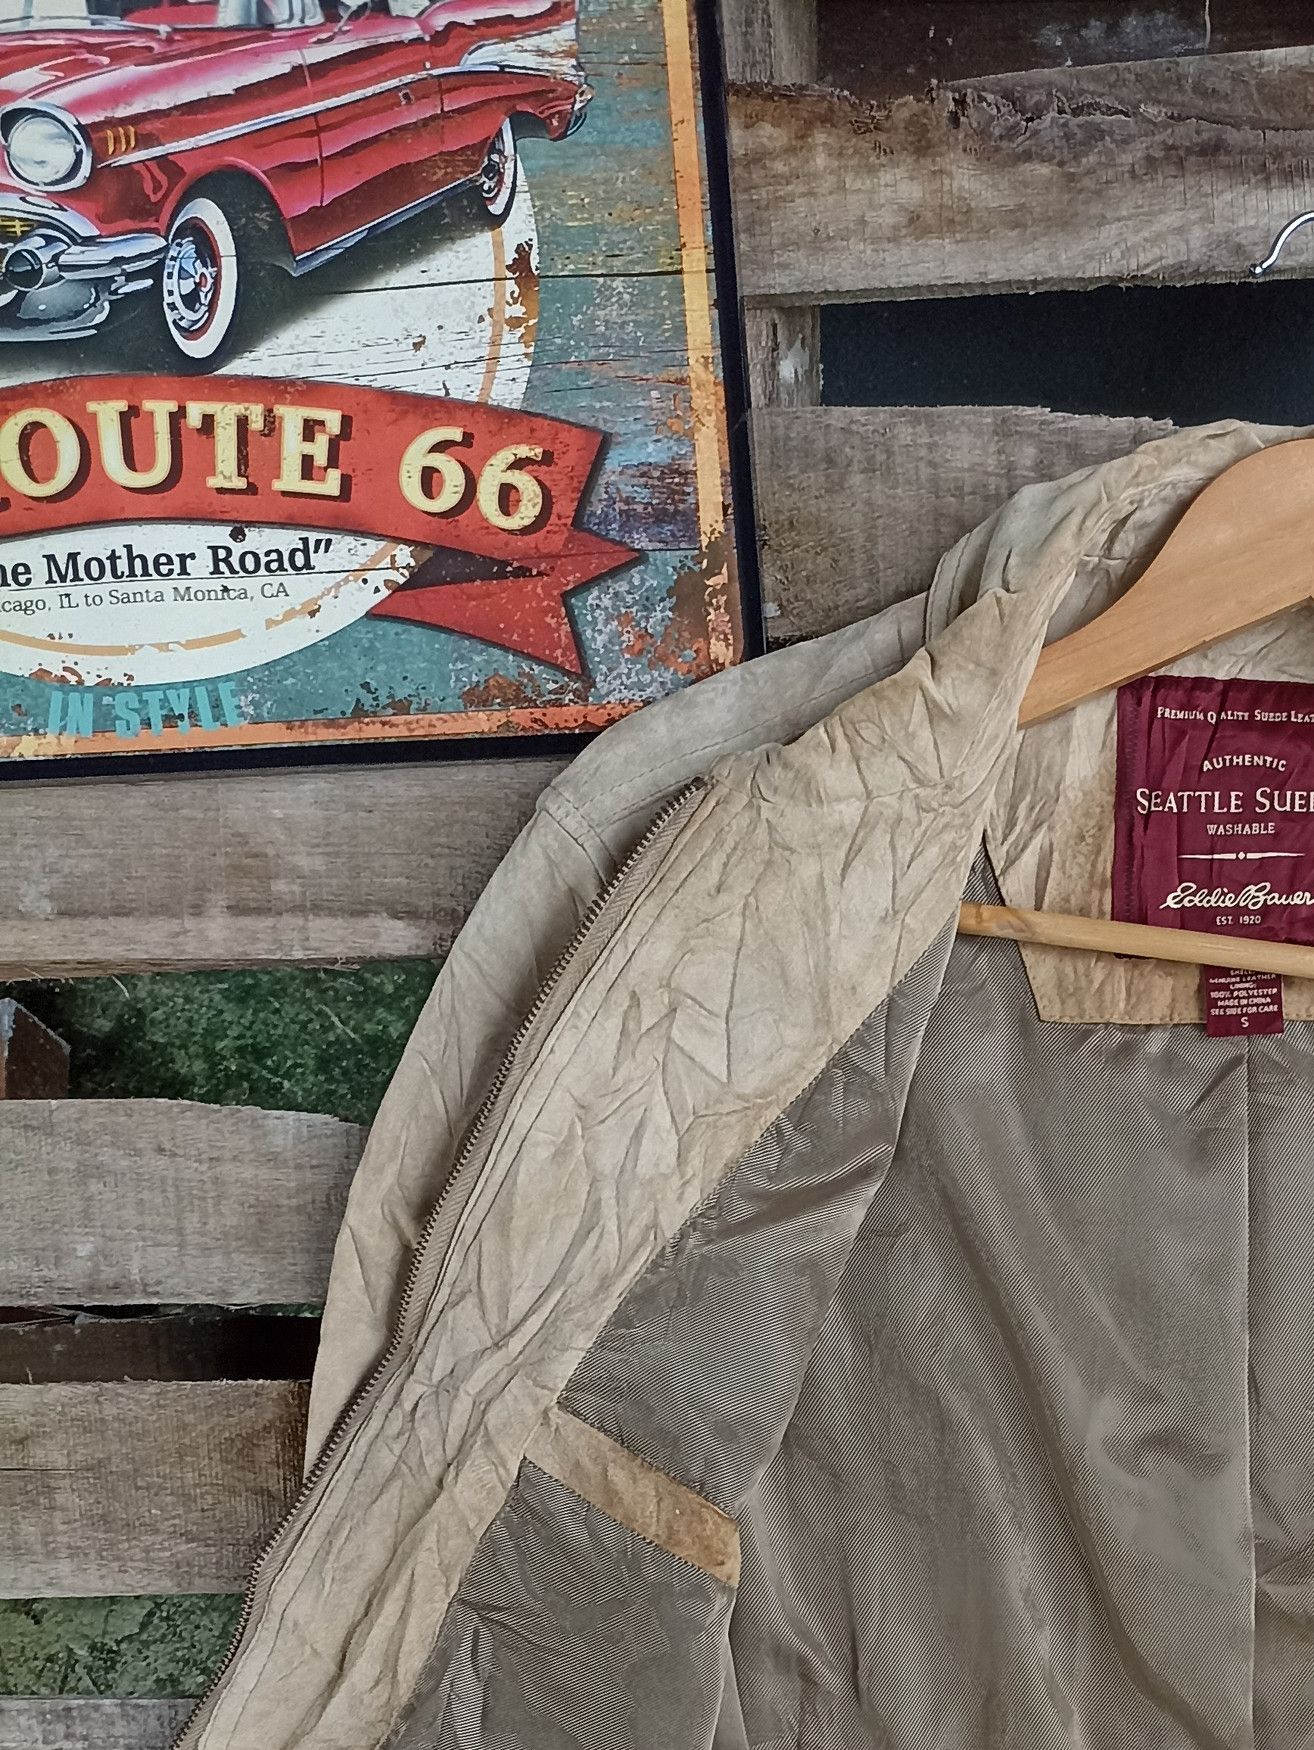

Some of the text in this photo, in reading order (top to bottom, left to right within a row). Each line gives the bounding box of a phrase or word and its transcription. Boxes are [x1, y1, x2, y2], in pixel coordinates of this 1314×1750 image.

[0, 400, 545, 532] OUTE 66
[42, 544, 196, 585] Mother
[207, 537, 333, 576] Road"
[0, 598, 52, 616] cago,
[84, 593, 104, 607] to
[108, 588, 165, 606] Santa
[173, 583, 254, 603] Monica,
[260, 581, 289, 599] CA
[48, 681, 245, 740] IN STYLE
[1157, 706, 1204, 721] PREMIUM
[1207, 711, 1250, 725] QALITY
[1254, 709, 1288, 722] SUEDE
[1202, 754, 1287, 772] AUTHENTIC
[1136, 788, 1243, 814] SEATTLE
[1206, 822, 1276, 836] WASHABLE
[1159, 882, 1240, 909] Eddie
[1239, 915, 1262, 925] 1920
[1233, 988, 1278, 997] POLYESTER
[1210, 1007, 1224, 1016] SEE
[1242, 1005, 1258, 1014] FOR
[1258, 1004, 1278, 1013] CARE
[1217, 999, 1239, 1007] MADE
[1240, 1016, 1250, 1028] S
